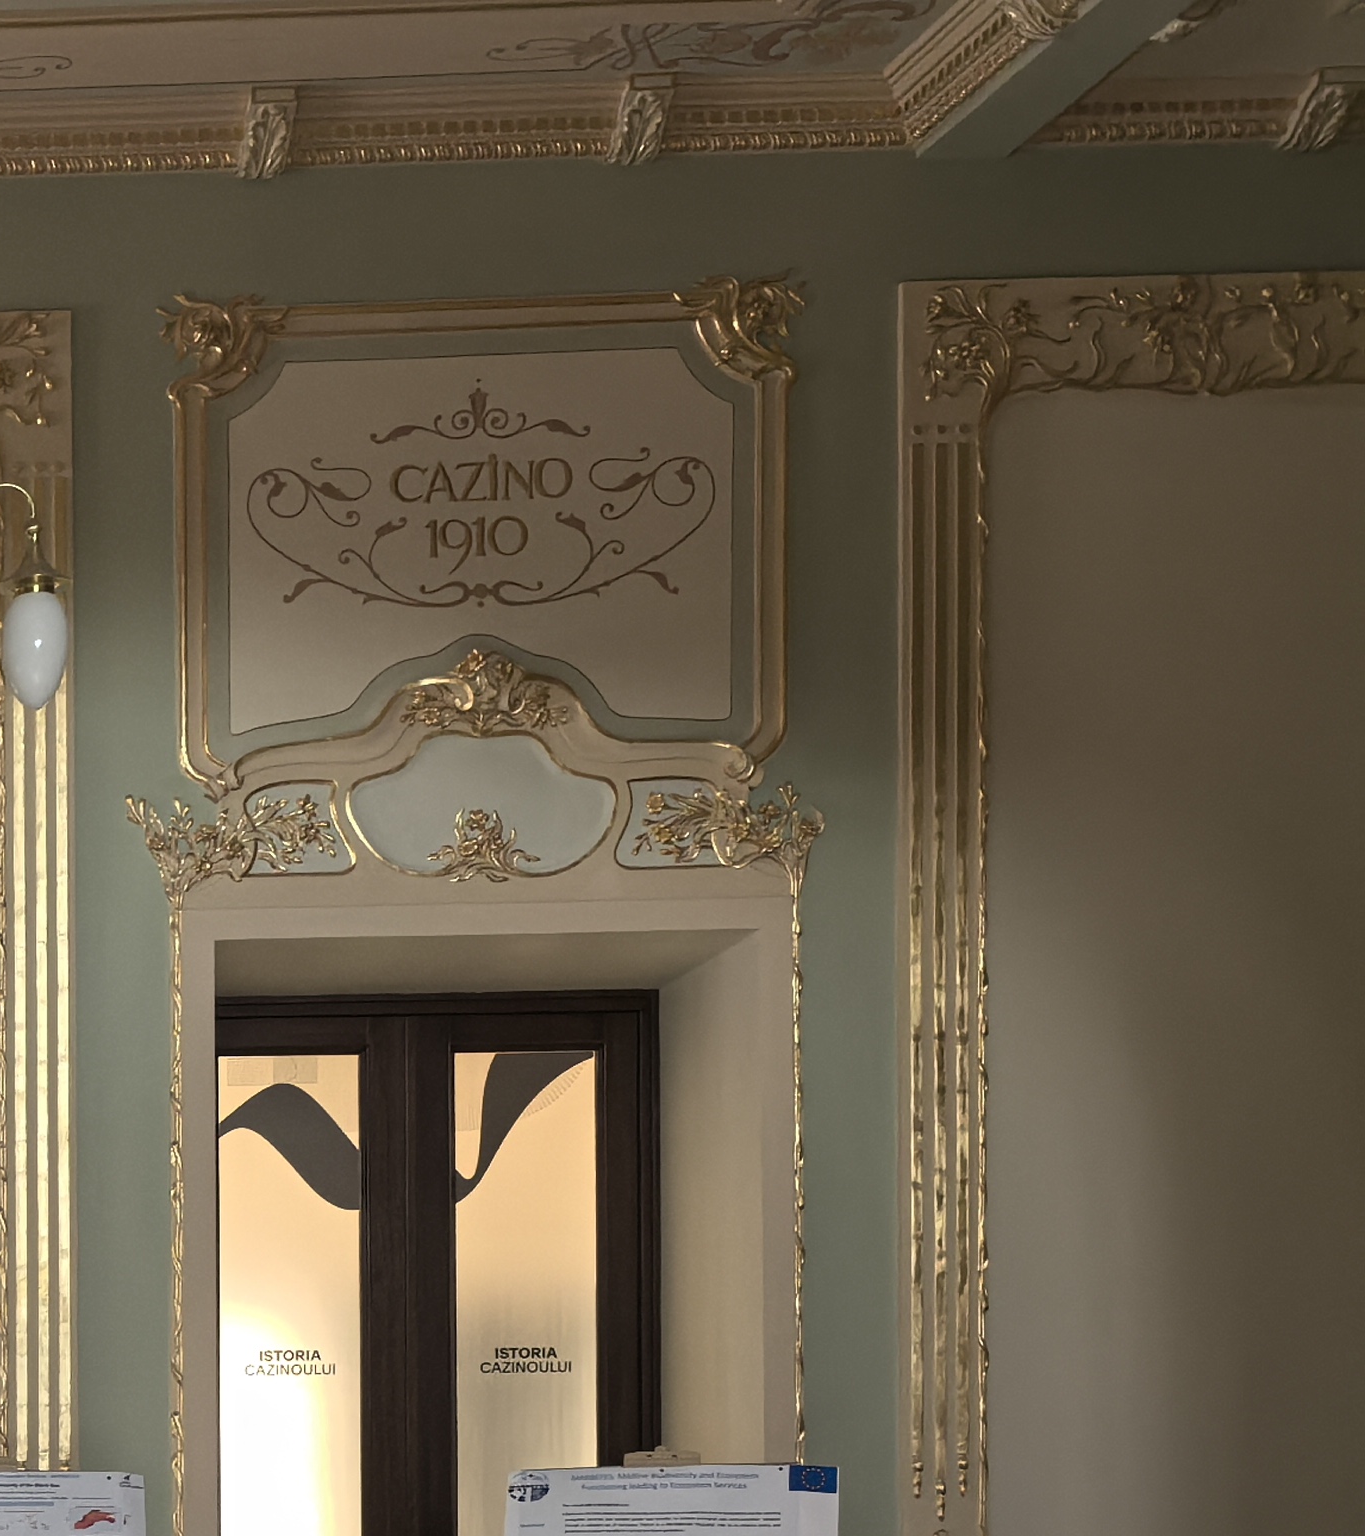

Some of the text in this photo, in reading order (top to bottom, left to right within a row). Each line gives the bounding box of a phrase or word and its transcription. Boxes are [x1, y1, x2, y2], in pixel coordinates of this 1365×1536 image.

[390, 453, 573, 504] CAZINO
[425, 516, 529, 576] 1910
[259, 1350, 321, 1362] ISTORIA
[495, 1347, 557, 1359] ISTORIA
[245, 1363, 335, 1376] CAZINOULUI
[480, 1361, 571, 1373] CAZINOULUI
